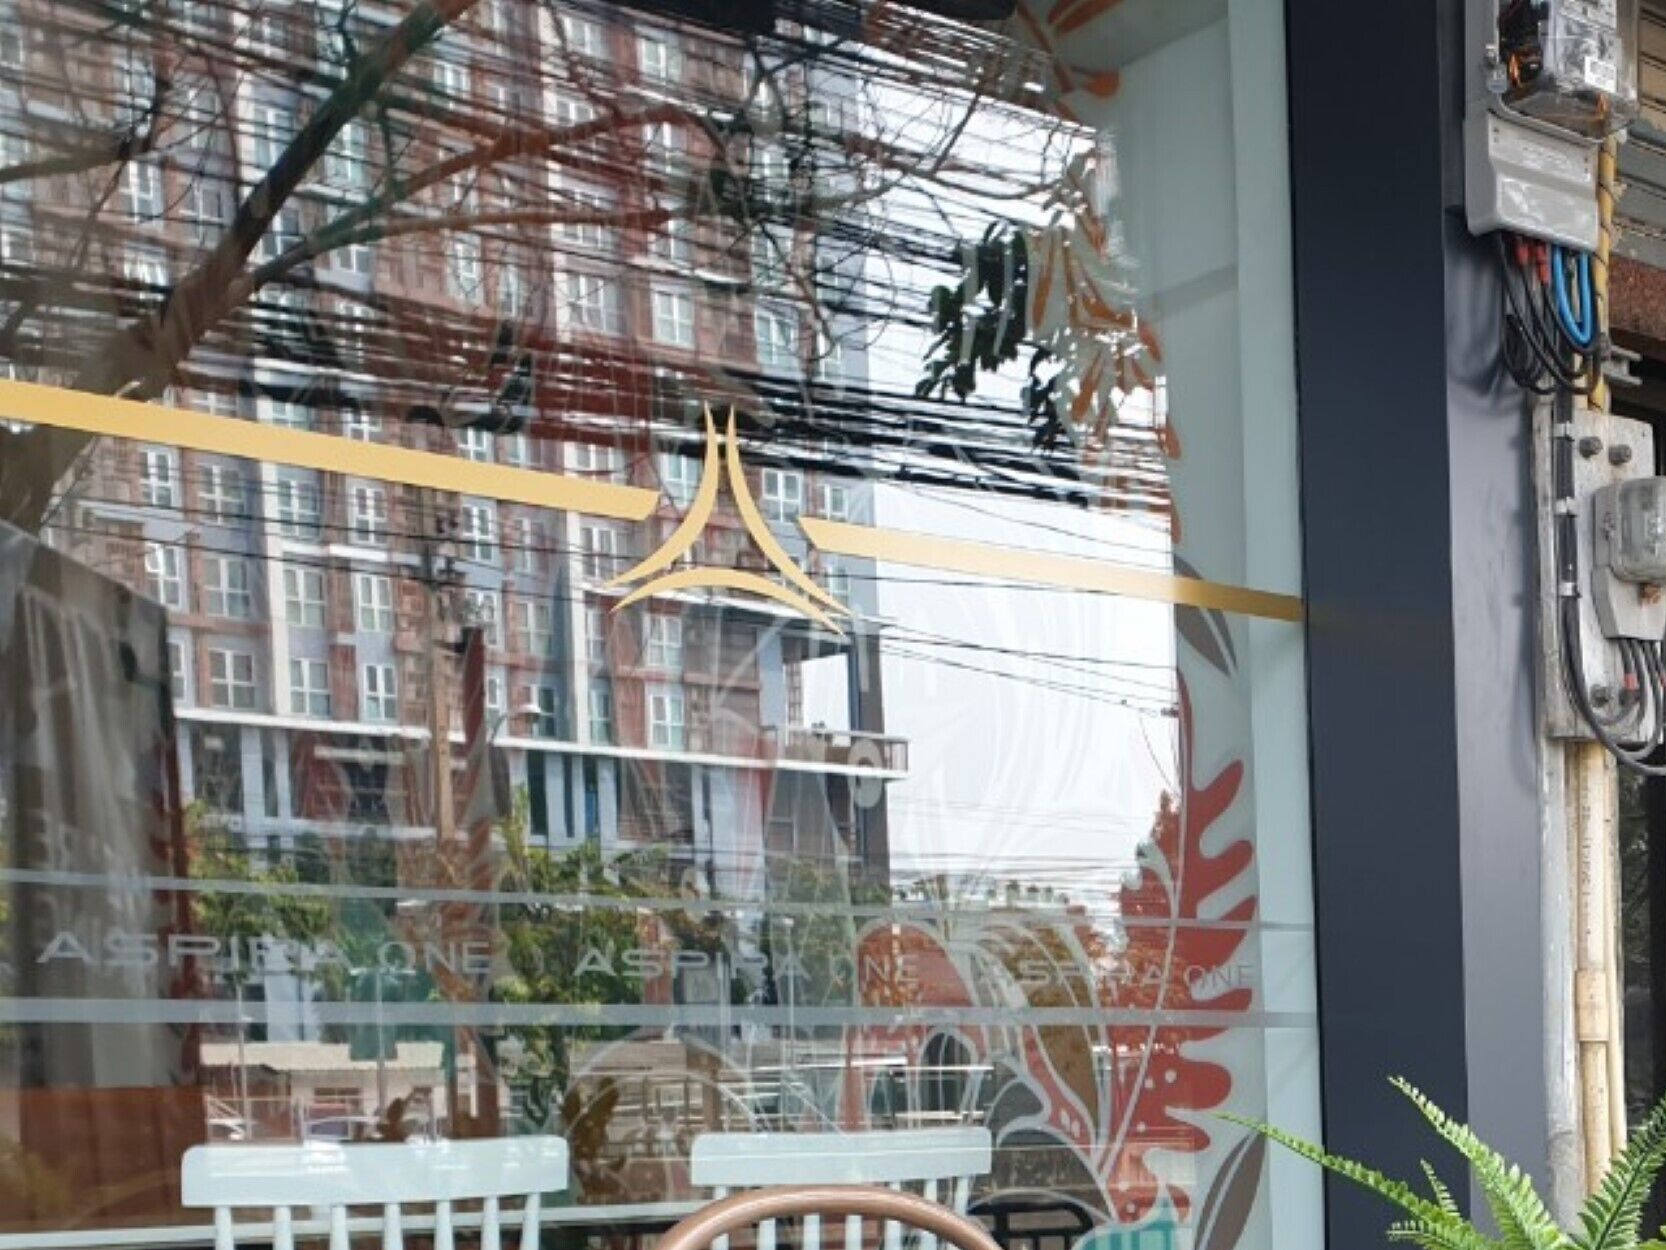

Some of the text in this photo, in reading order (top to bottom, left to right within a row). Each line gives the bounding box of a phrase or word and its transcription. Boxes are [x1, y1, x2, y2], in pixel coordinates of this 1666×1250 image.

[36, 931, 493, 975] ASPIRA ONE
[574, 947, 920, 983] ASPIRA ONE
[1183, 963, 1259, 987] ONE
